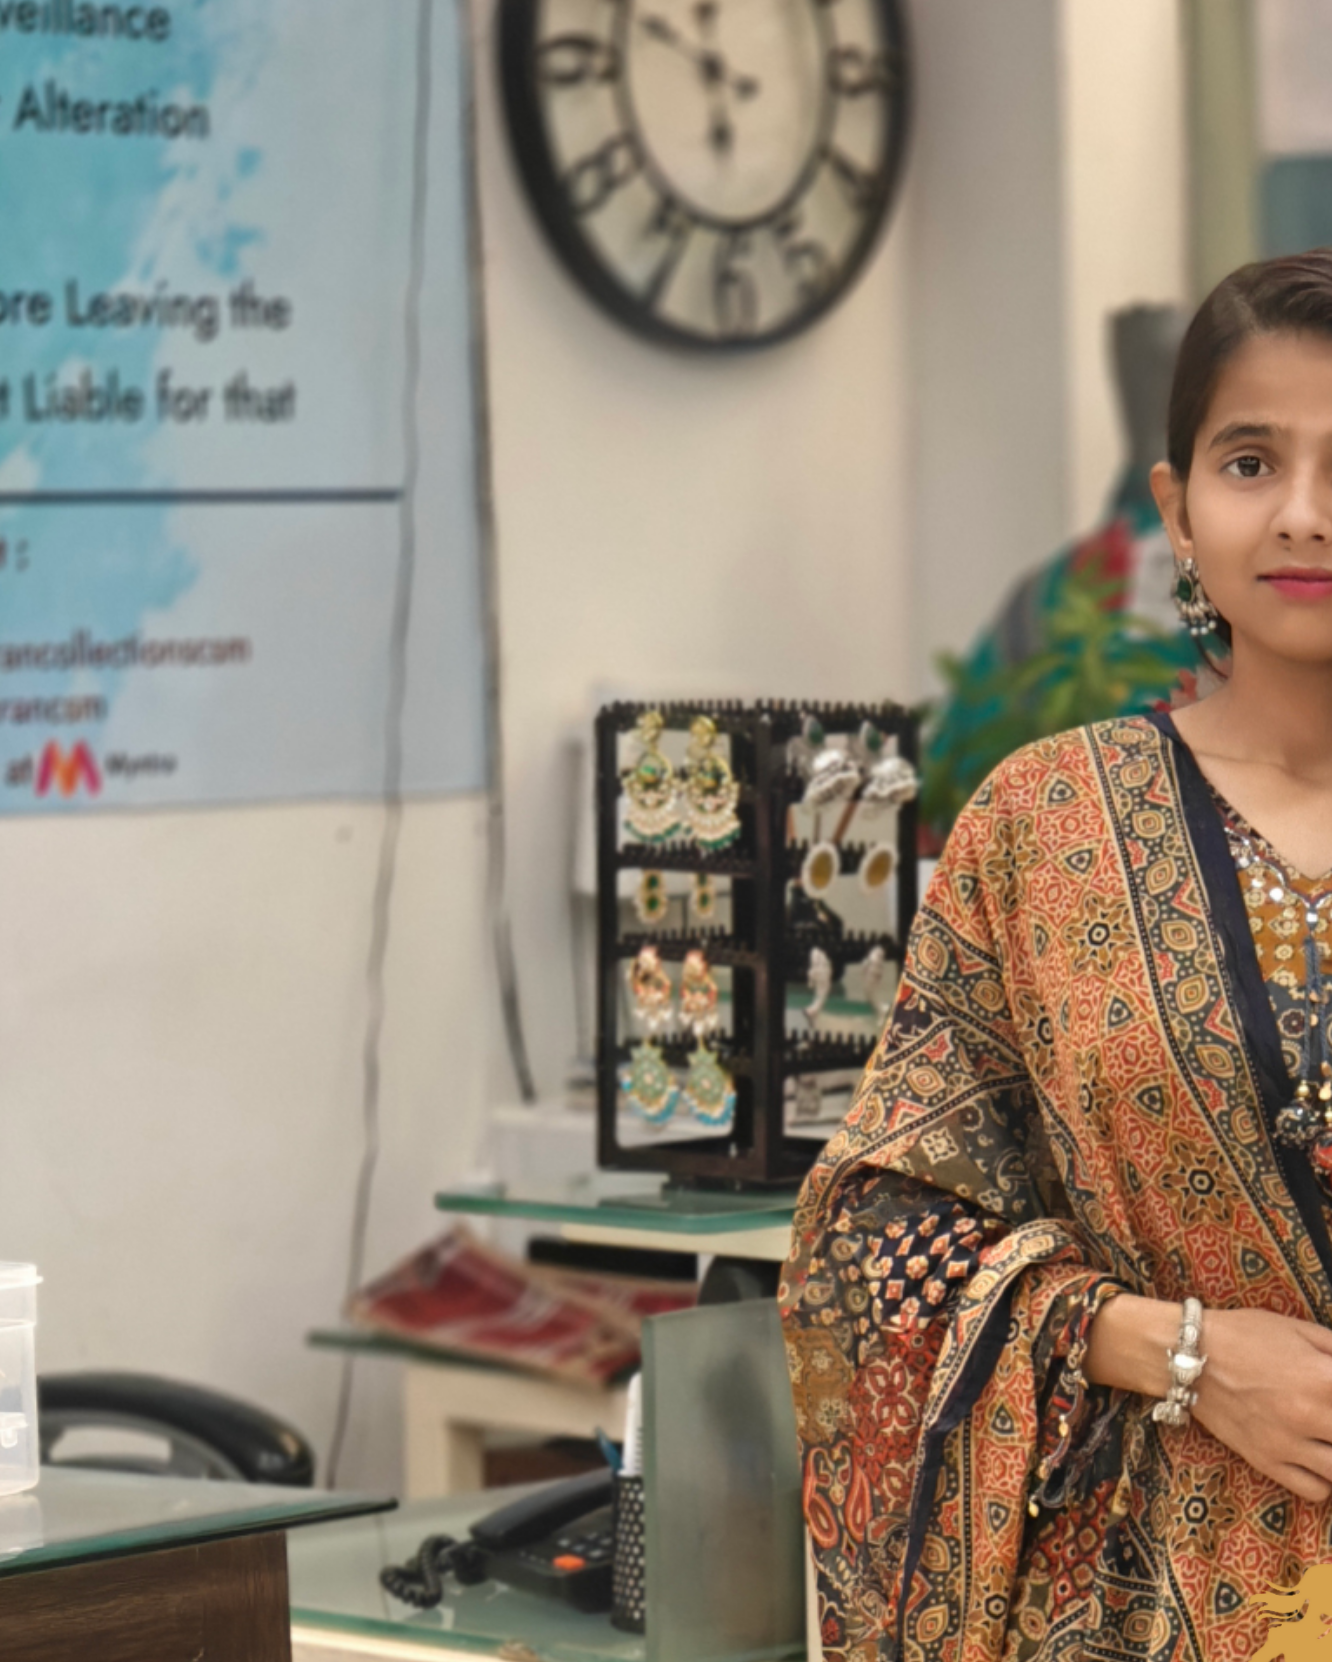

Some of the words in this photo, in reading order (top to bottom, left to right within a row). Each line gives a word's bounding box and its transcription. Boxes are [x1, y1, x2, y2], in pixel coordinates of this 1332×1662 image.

[13, 80, 210, 138] Alteration
[65, 279, 220, 342] Leaving
[228, 279, 291, 330] the
[23, 368, 145, 422] Liable
[156, 368, 211, 422] for
[224, 369, 296, 422] that
